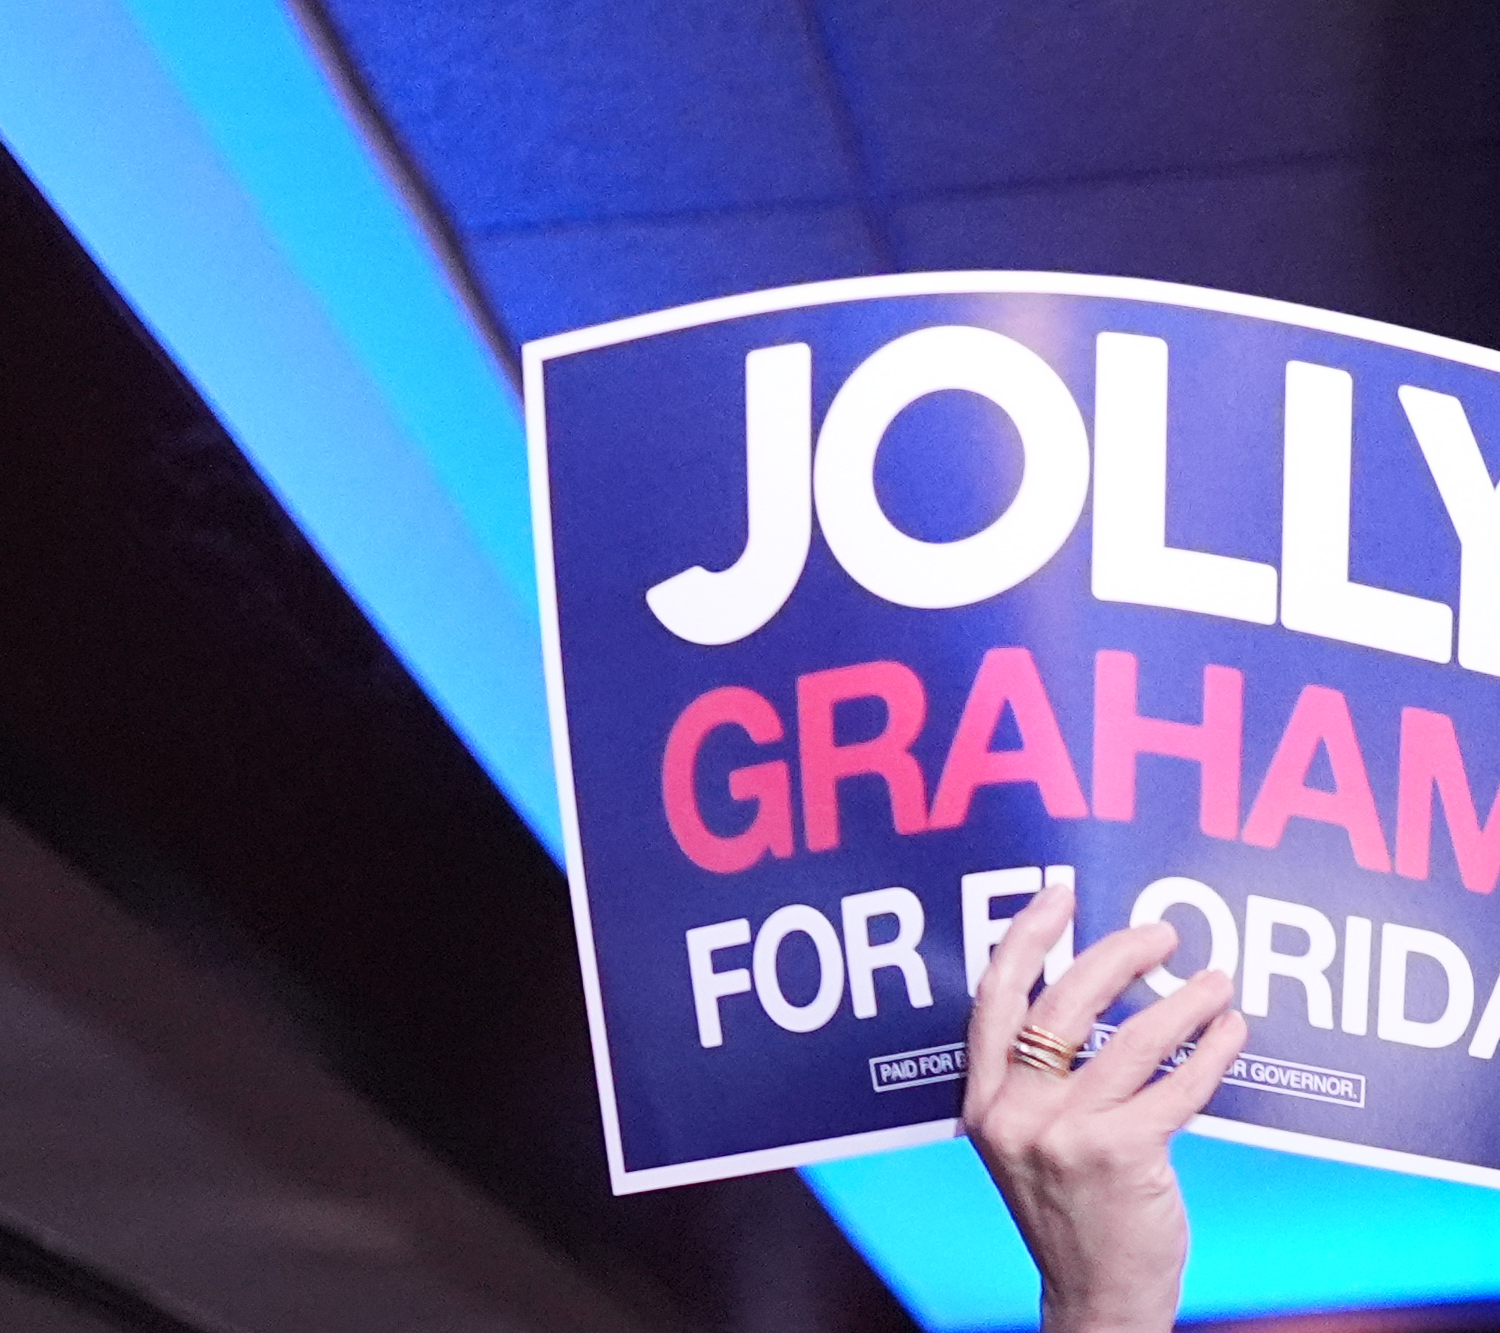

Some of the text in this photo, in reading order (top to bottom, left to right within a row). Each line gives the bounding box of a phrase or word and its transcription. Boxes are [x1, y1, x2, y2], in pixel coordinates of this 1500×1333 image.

[686, 886, 933, 1048] FOR
[880, 1059, 918, 1083] PAID
[919, 1052, 954, 1076] FOR
